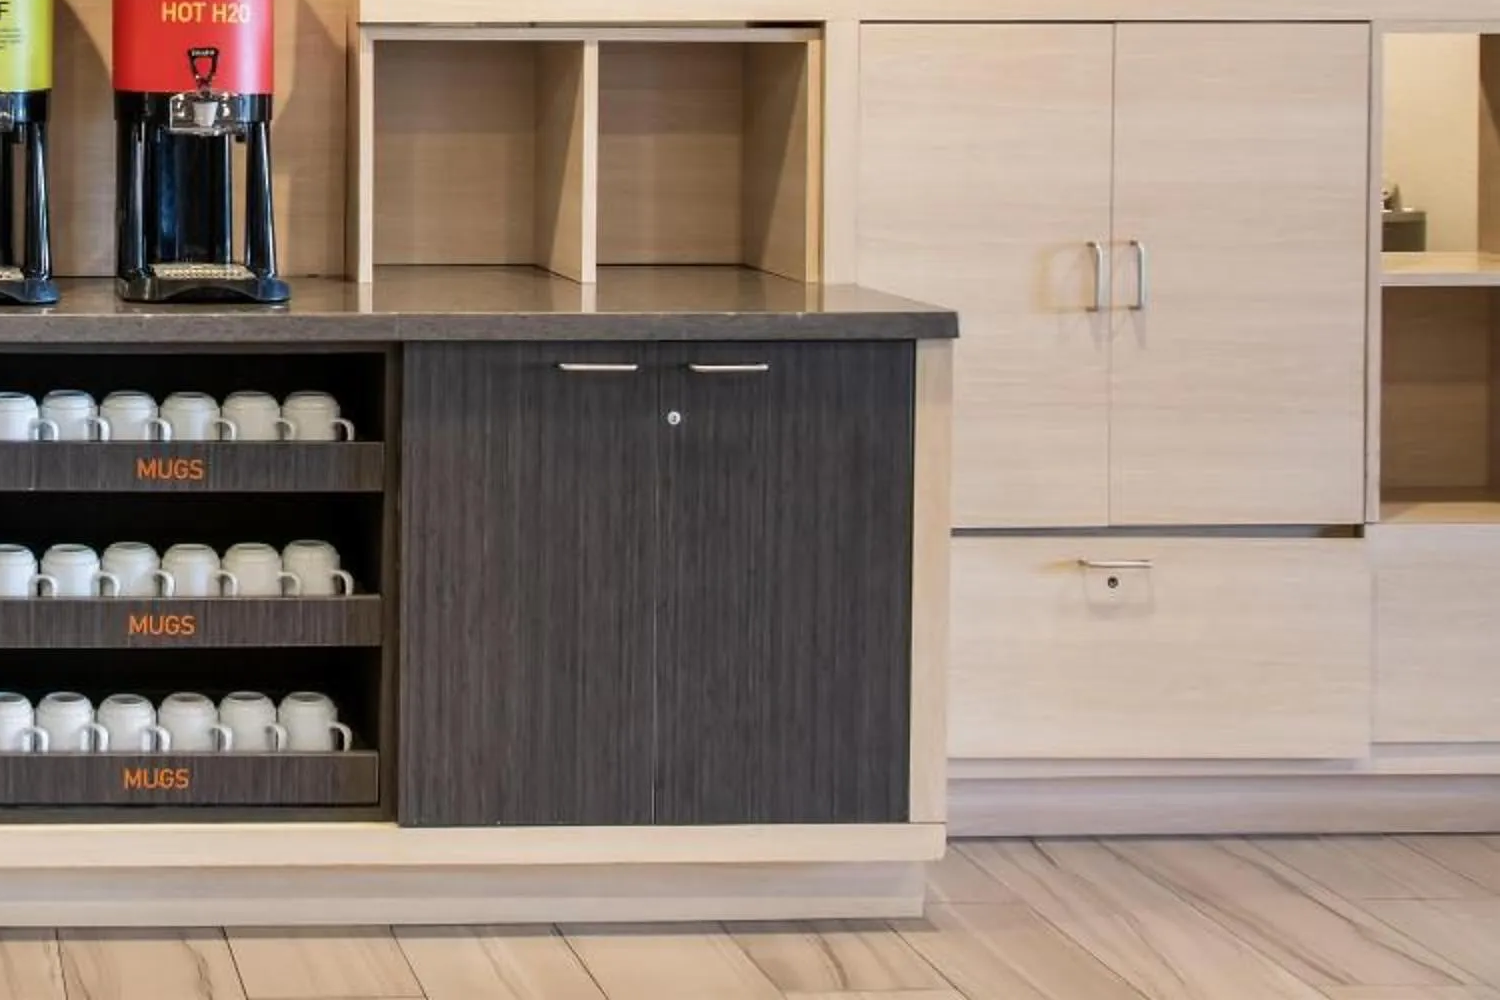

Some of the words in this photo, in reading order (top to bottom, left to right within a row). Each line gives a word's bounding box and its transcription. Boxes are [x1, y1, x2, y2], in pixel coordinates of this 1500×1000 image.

[161, 1, 207, 23] HOT
[136, 458, 204, 480] MUGS
[128, 615, 195, 636] MUGS
[123, 767, 189, 789] MUGS
